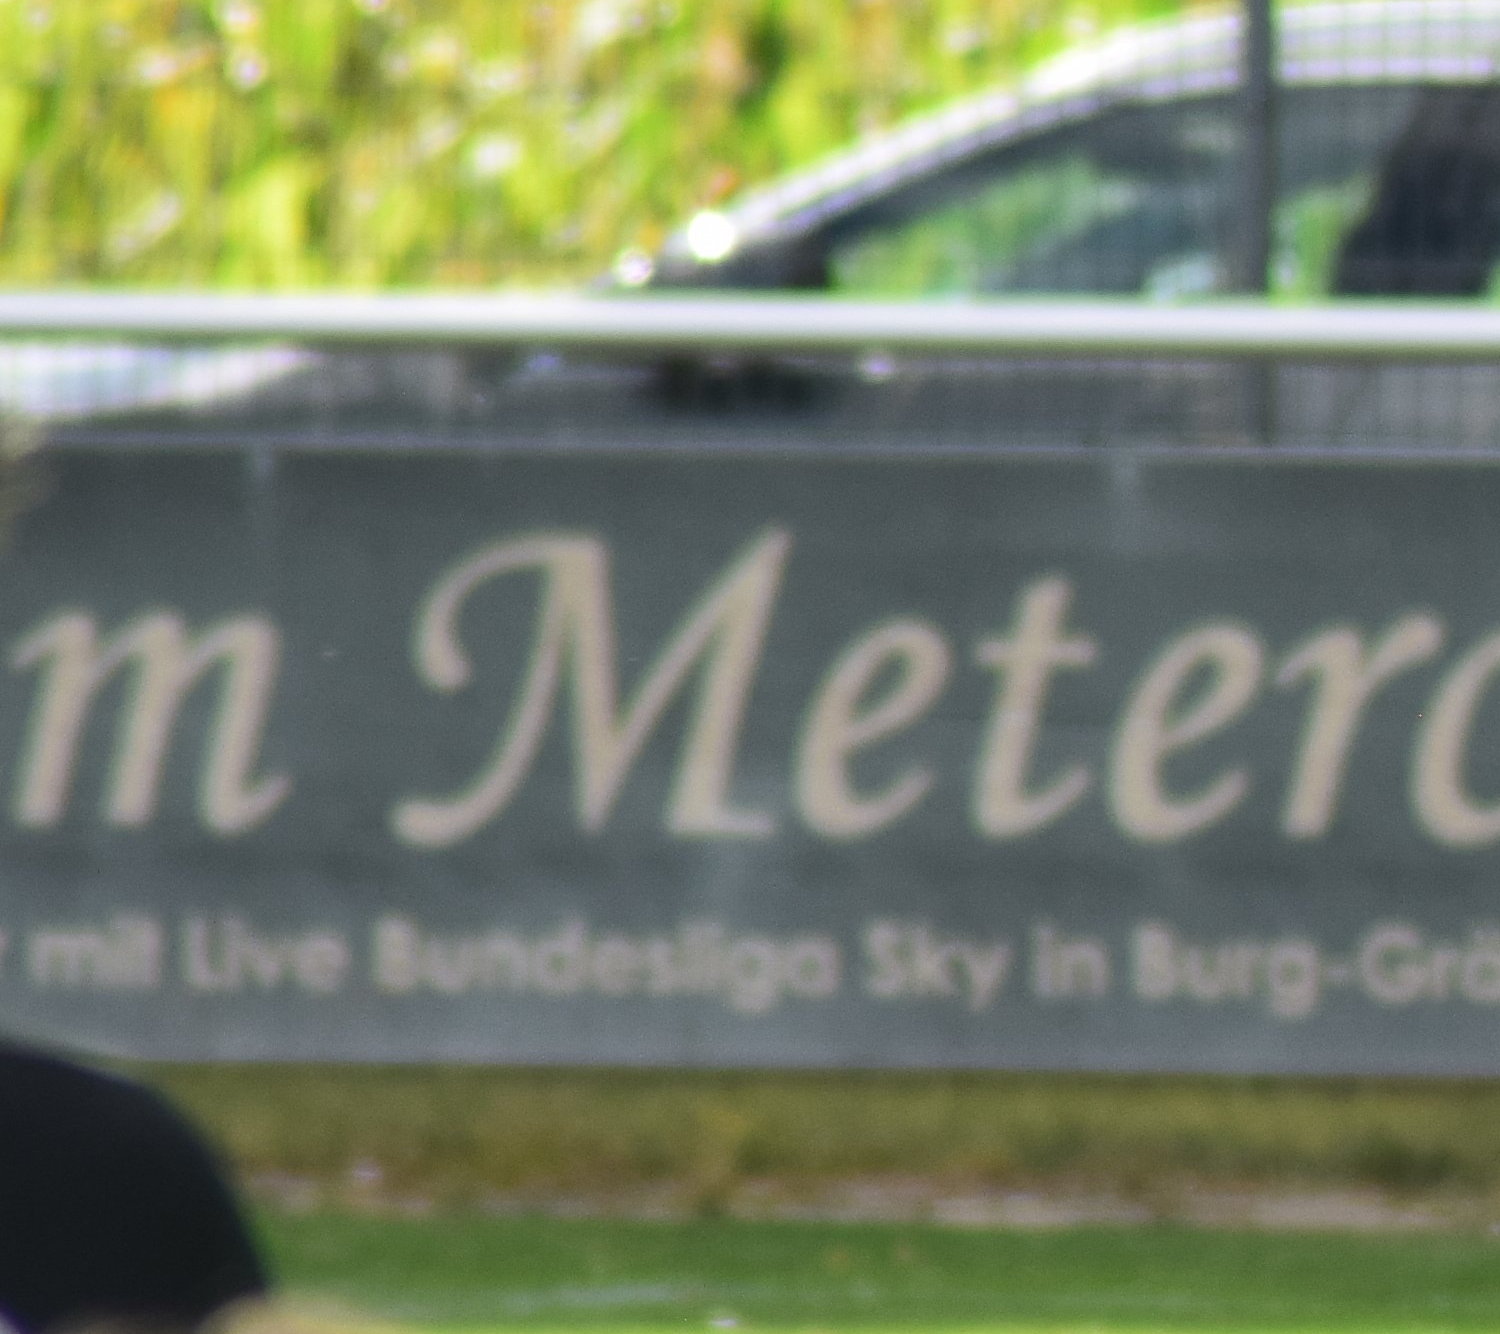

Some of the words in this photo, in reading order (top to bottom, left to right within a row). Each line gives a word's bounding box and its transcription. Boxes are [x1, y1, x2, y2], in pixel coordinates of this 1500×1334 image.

[30, 914, 163, 988] mit
[185, 913, 347, 993] Live
[375, 913, 840, 1014] Bundesliga
[866, 917, 1010, 1013] Sky
[1033, 917, 1110, 1000] in
